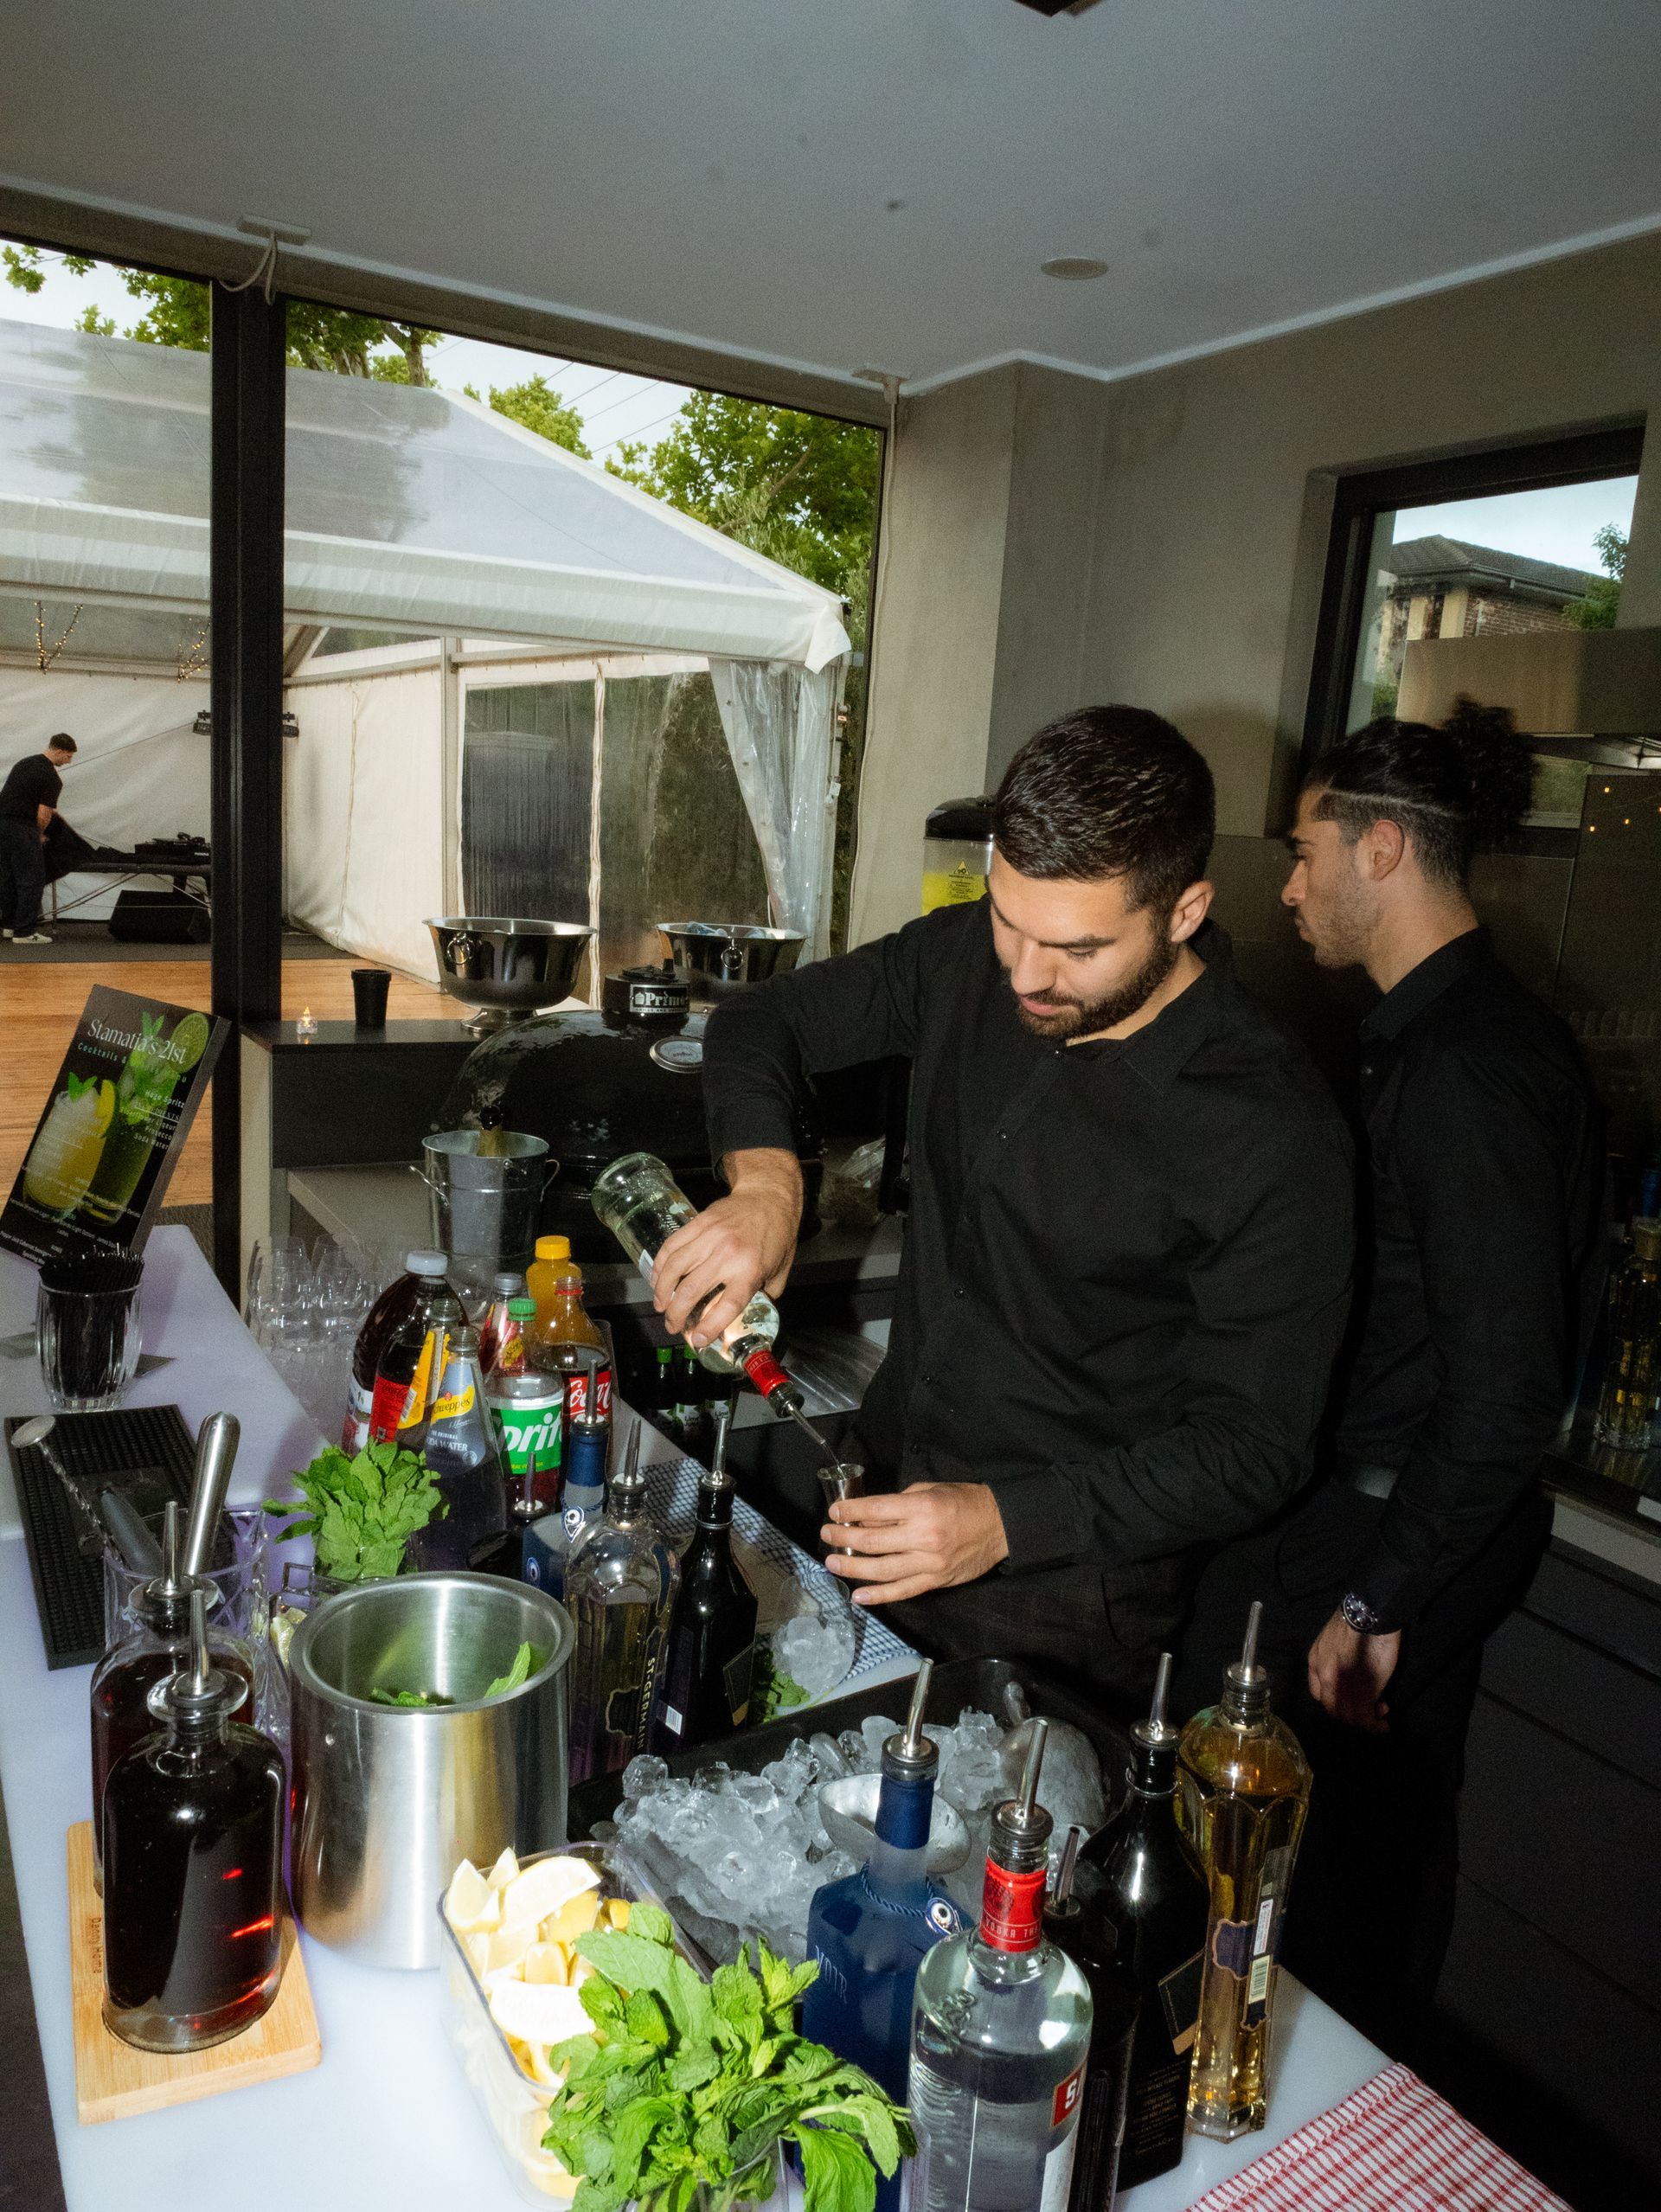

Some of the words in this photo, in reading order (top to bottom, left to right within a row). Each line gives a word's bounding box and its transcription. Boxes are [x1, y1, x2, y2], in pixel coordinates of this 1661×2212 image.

[87, 1018, 158, 1055] Stamatia's
[158, 1040, 187, 1065] 21st
[77, 1042, 119, 1062] Cocktails
[164, 1095, 185, 1108] Spritz
[439, 1440, 468, 1452] WATER
[984, 1917, 1016, 1939] VODKA
